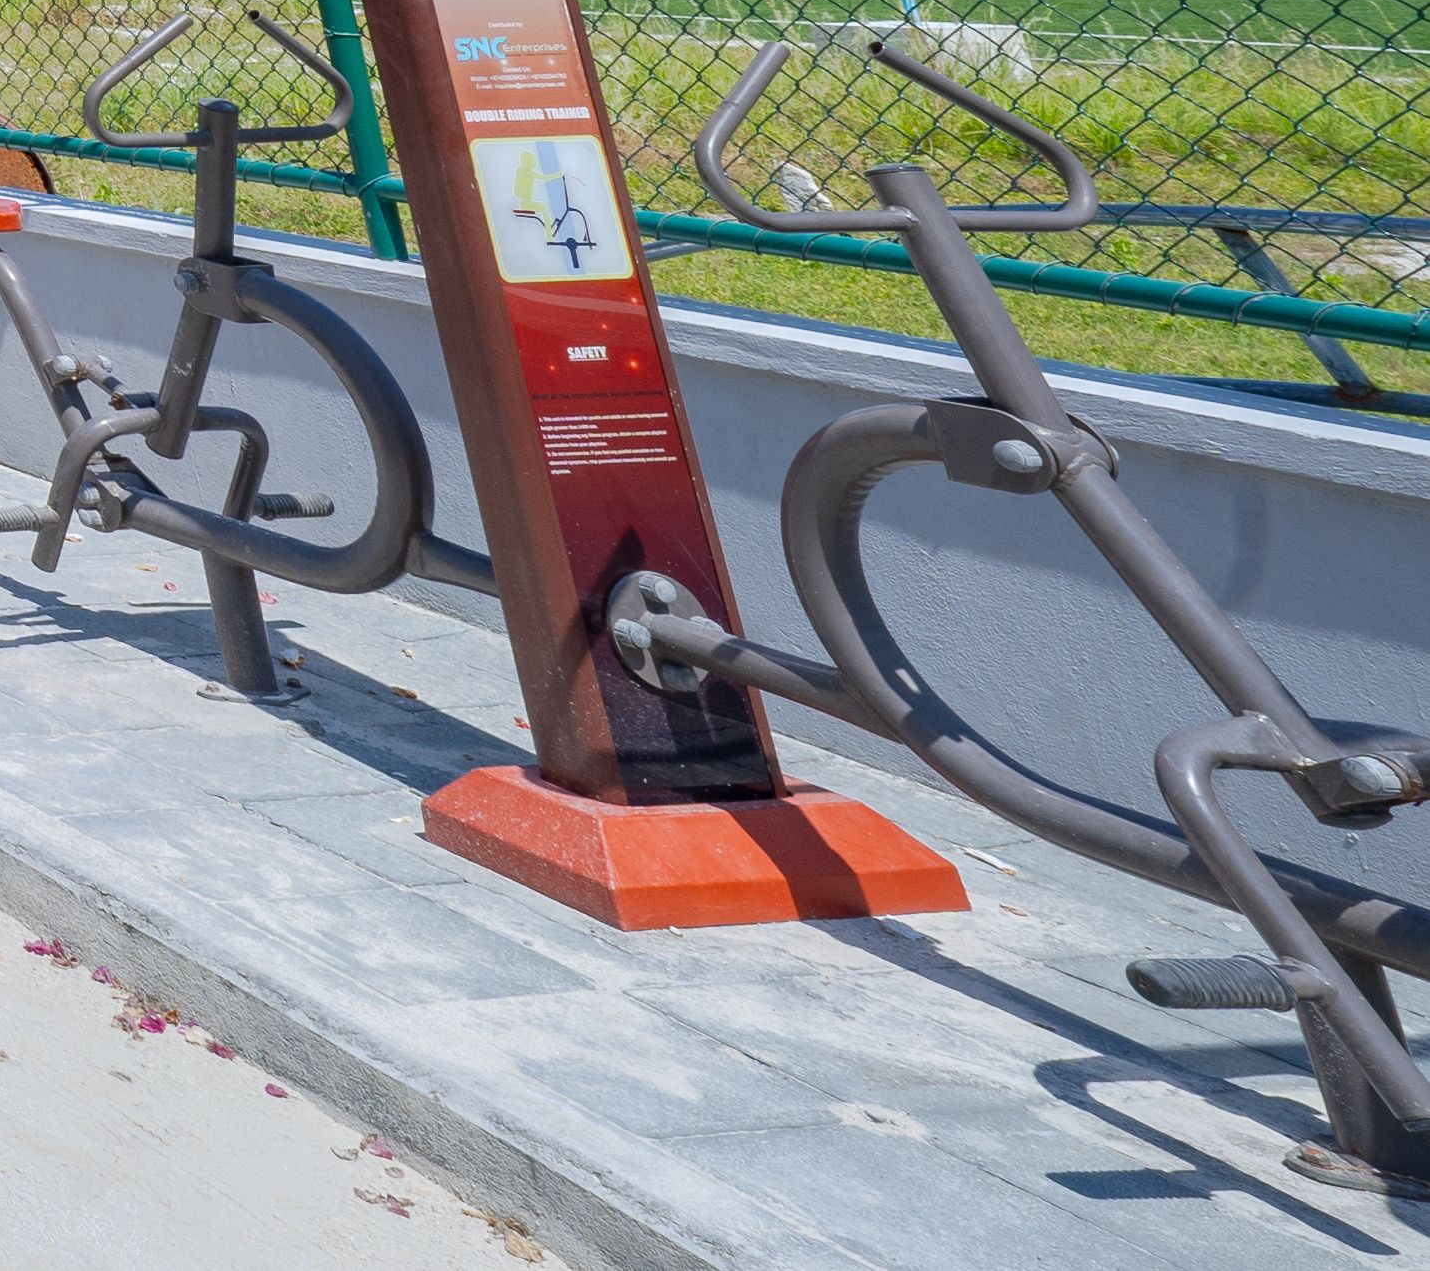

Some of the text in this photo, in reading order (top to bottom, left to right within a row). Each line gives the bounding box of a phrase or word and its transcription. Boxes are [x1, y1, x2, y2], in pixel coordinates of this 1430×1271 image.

[454, 36, 567, 61] SNC Enterprises
[464, 106, 590, 122] DOUBLE RIDING TRAINER
[567, 346, 607, 359] SAFETY
